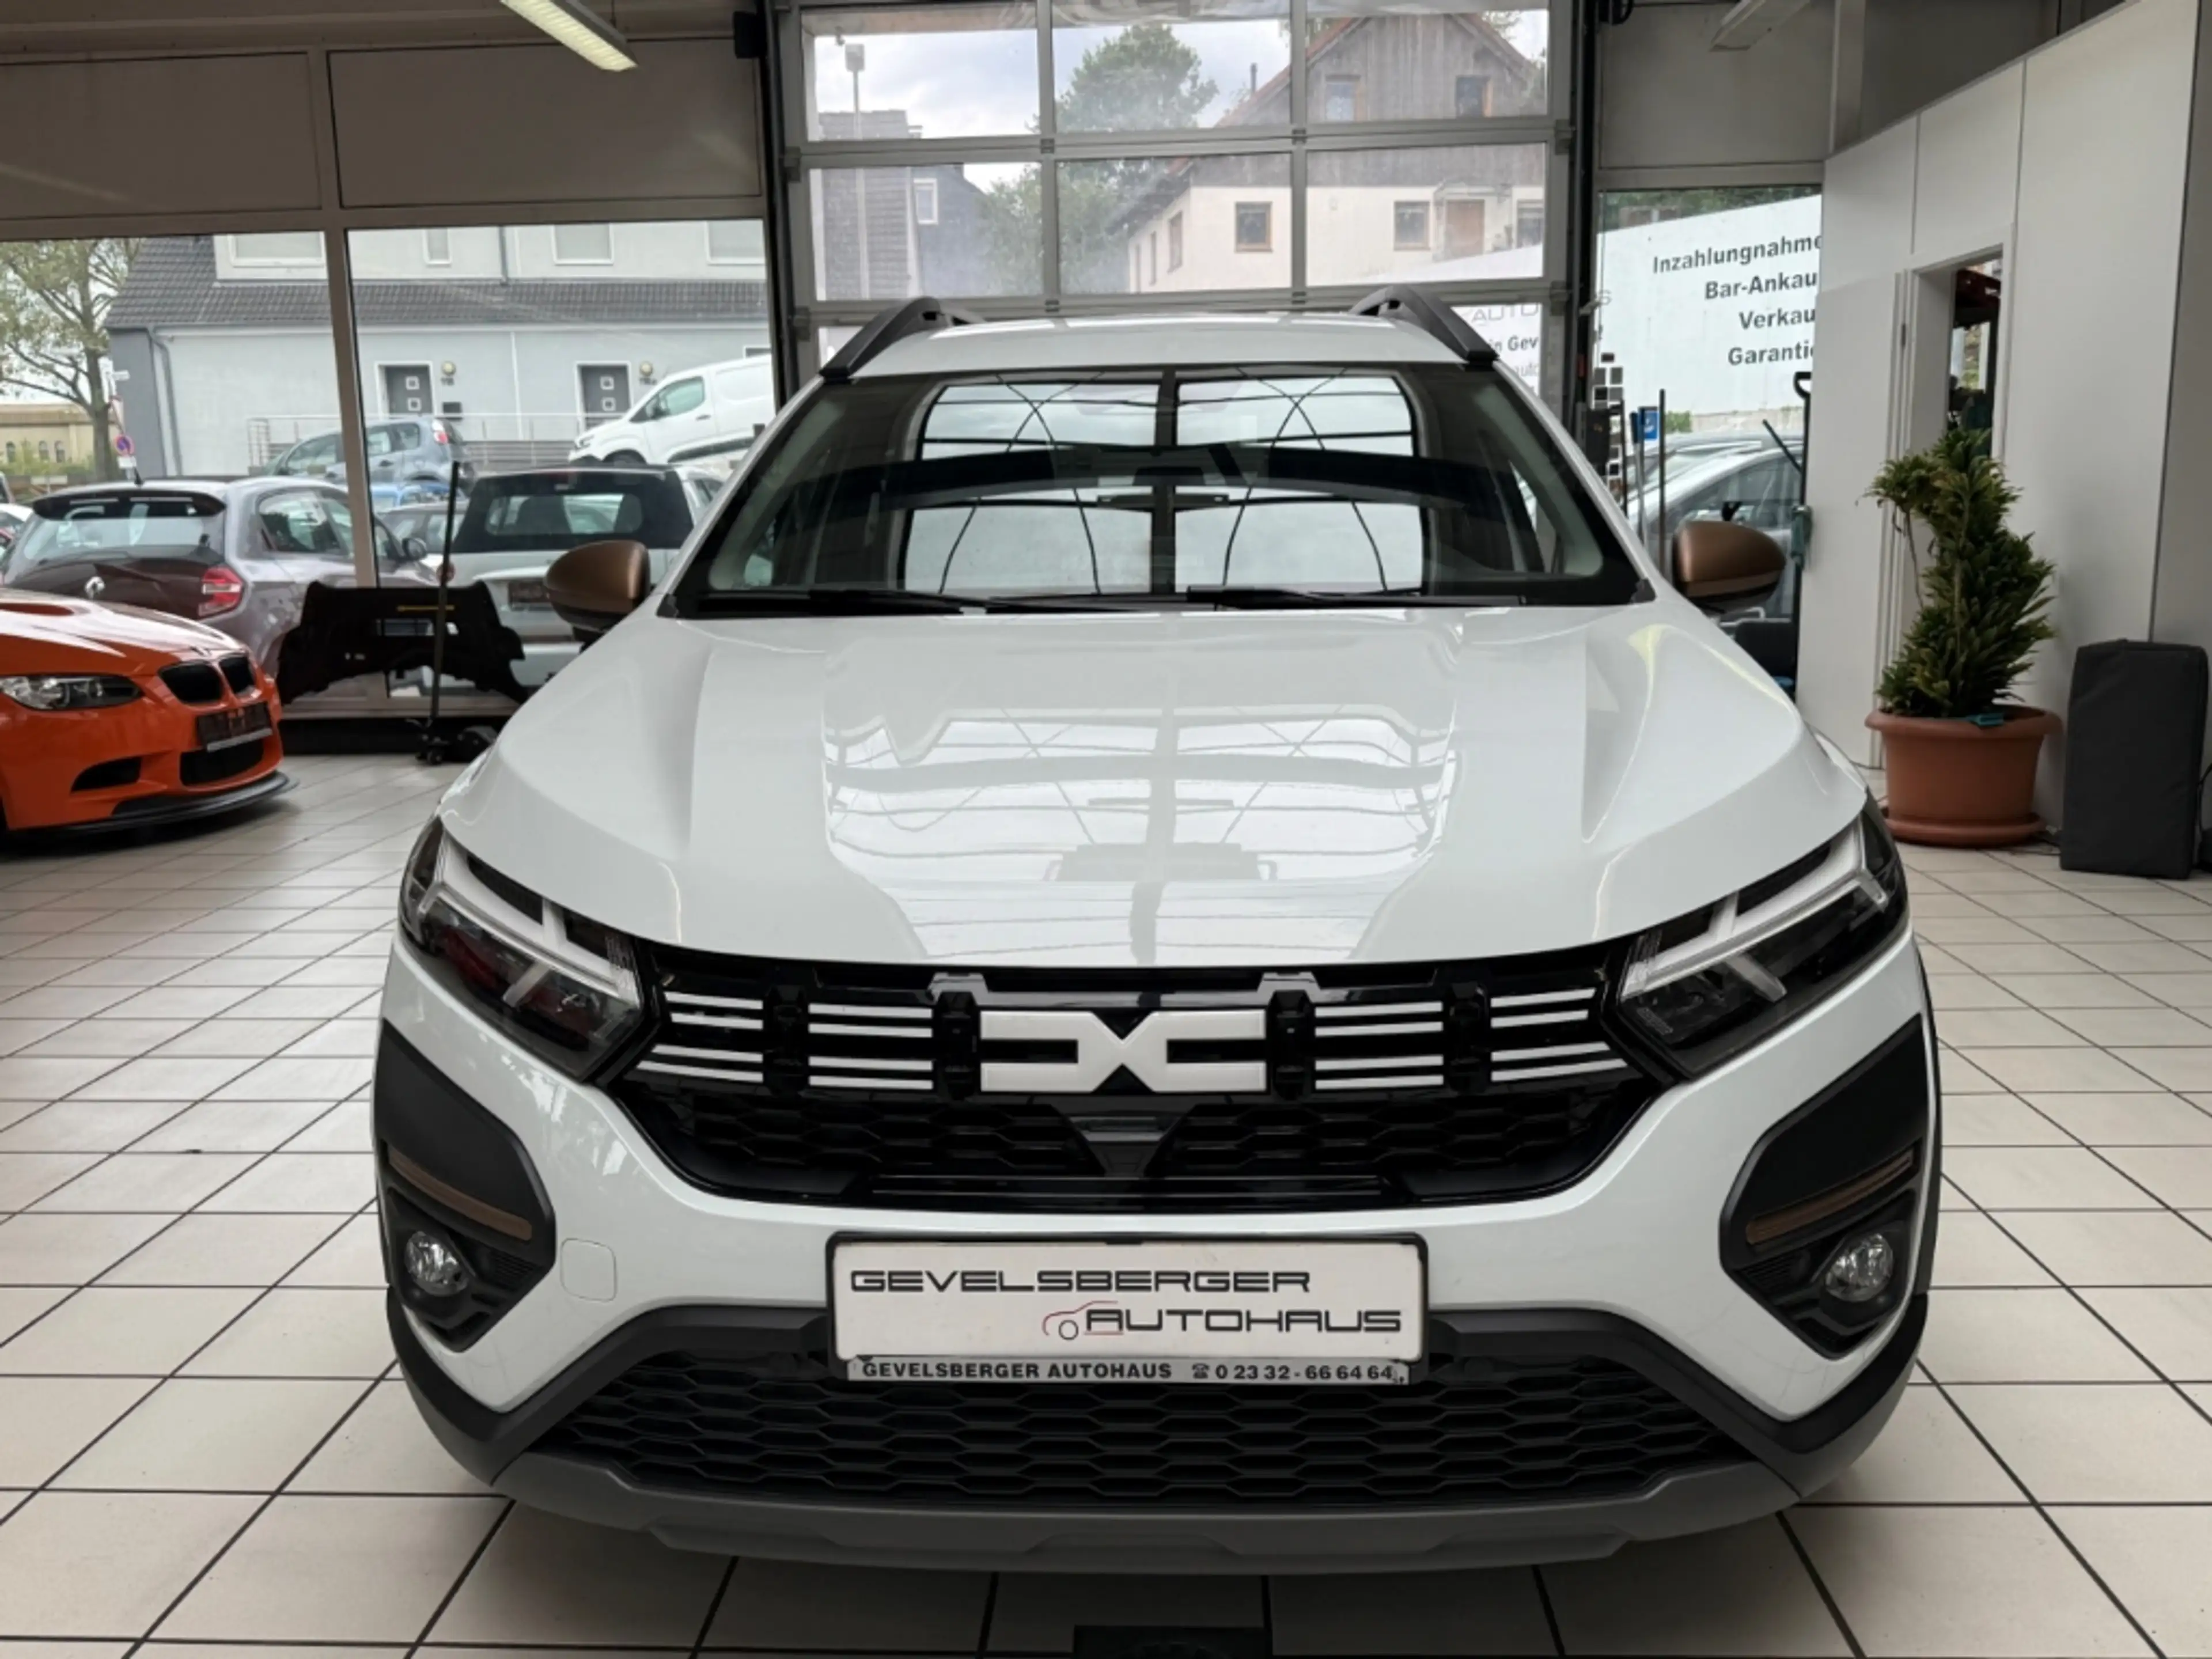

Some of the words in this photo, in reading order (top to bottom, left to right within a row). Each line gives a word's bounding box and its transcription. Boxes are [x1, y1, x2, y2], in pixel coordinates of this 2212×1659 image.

[1728, 339, 1814, 365] Garanti
[850, 1270, 1310, 1293] GEVELSBERGER
[1086, 1309, 1402, 1332] AUTOHAUS
[862, 1362, 1040, 1378] GEVELSBERGER
[1047, 1362, 1172, 1379] AUTOHAUS
